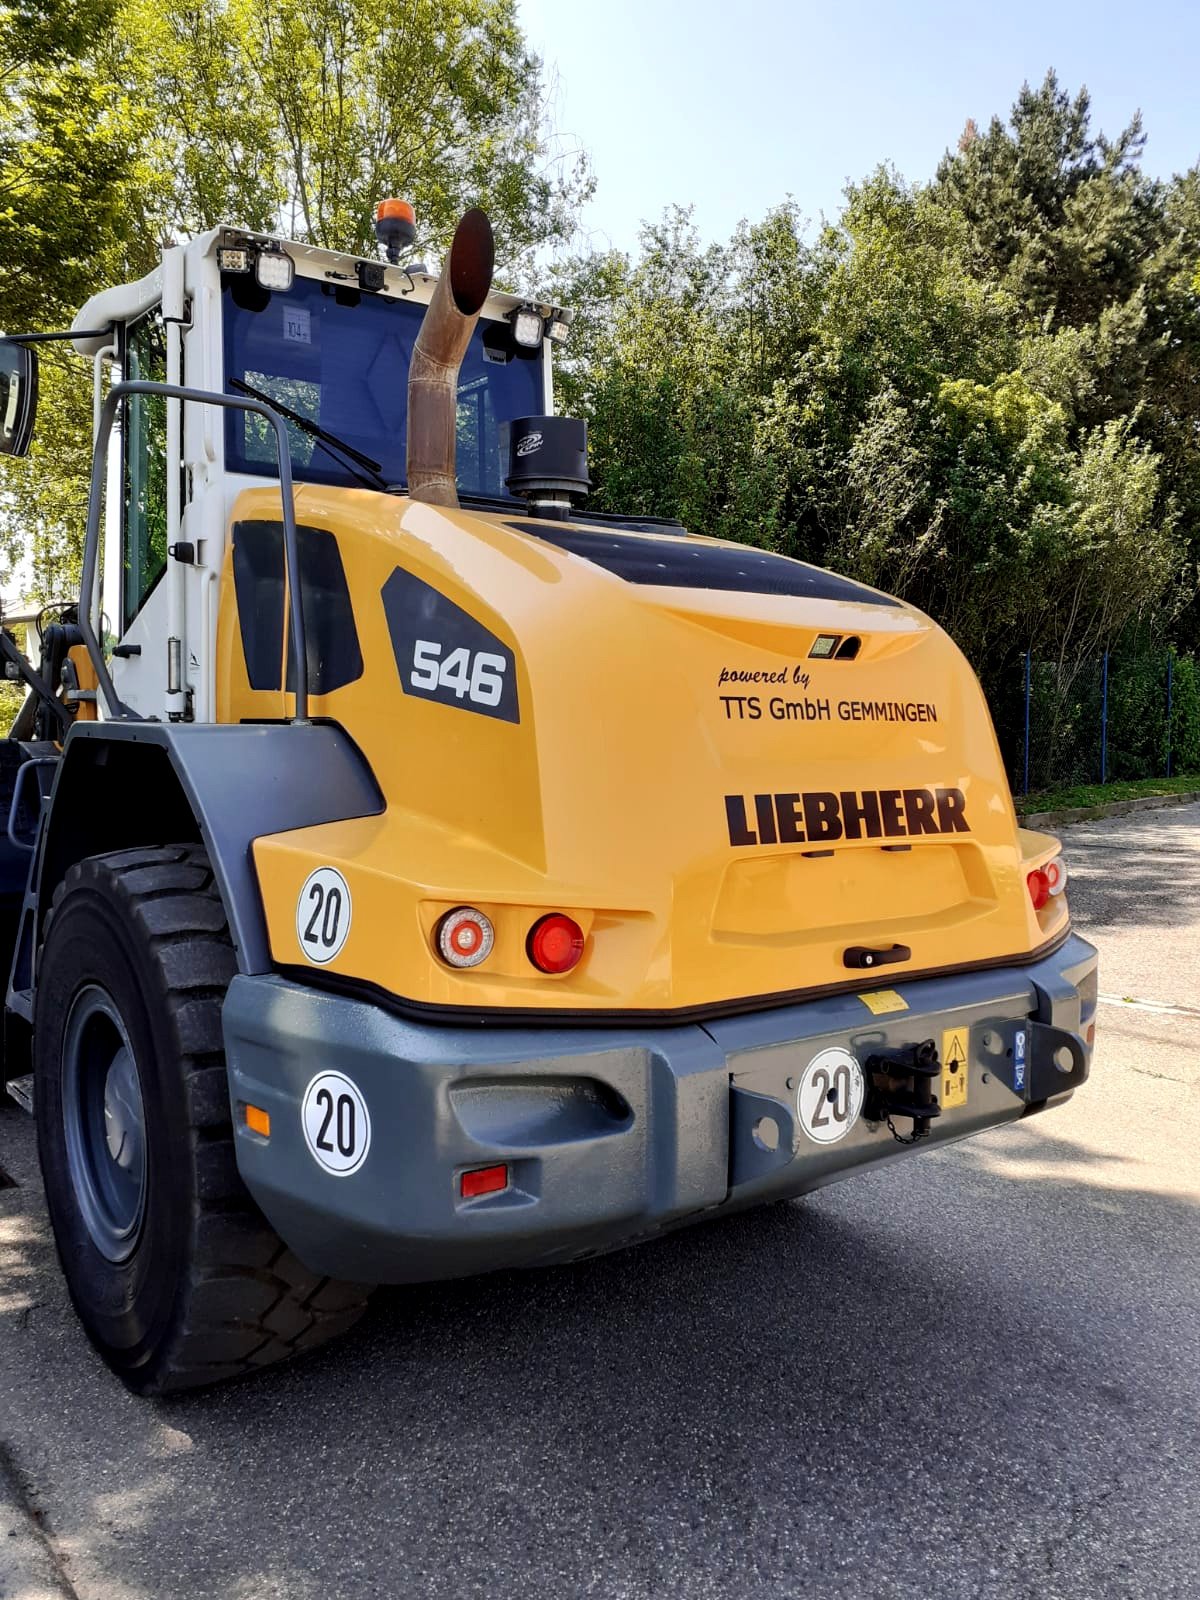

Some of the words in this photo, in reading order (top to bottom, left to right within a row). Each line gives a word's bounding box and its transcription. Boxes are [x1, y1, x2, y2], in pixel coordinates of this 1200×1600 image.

[410, 640, 505, 706] 546
[718, 667, 788, 687] powered
[793, 666, 811, 689] by
[719, 696, 762, 720] TTS
[769, 697, 831, 720] GmbH
[838, 701, 938, 722] GEMMINGEN
[724, 788, 972, 847] LIEBHERR
[303, 883, 342, 945] 20
[315, 1088, 356, 1158] 20
[811, 1065, 850, 1128] 20
